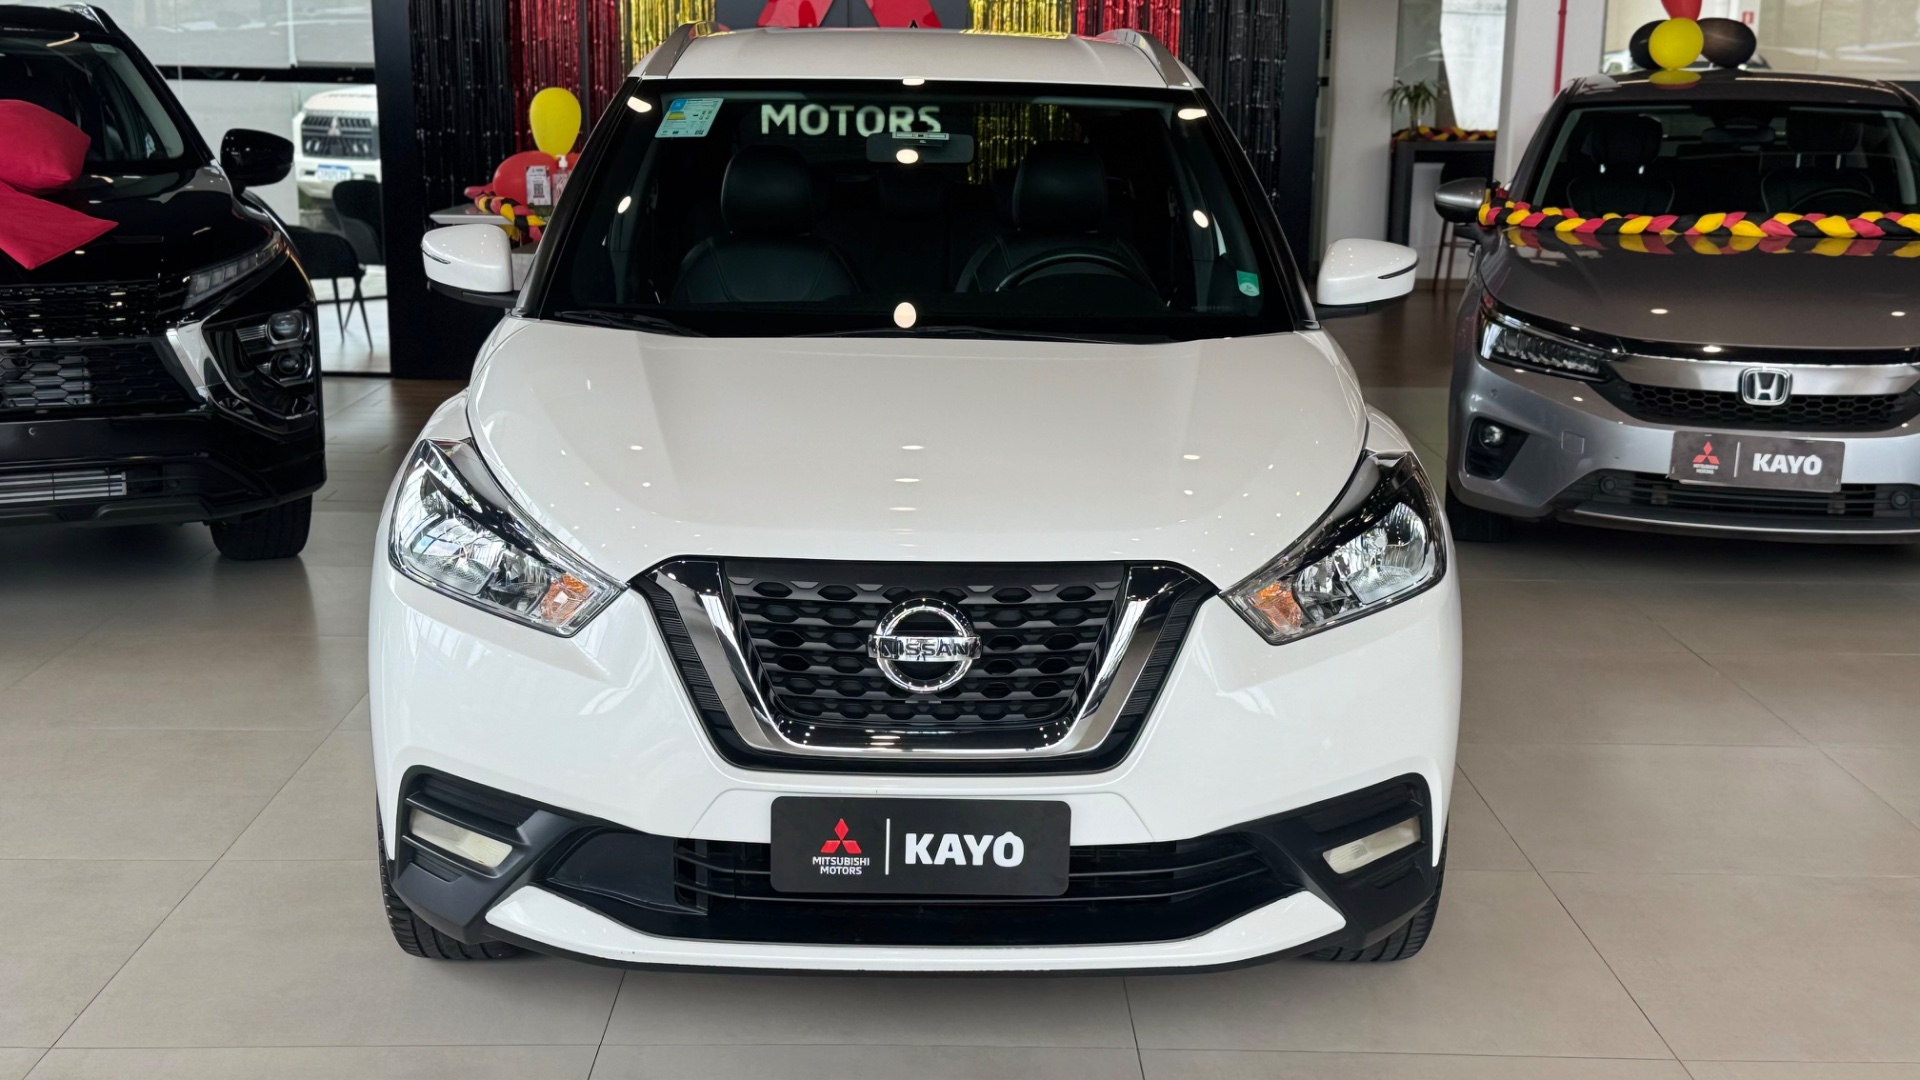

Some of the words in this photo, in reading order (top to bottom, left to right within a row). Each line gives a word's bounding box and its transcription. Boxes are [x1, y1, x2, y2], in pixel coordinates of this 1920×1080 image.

[761, 104, 942, 137] MOTORS
[1752, 453, 1823, 476] KAYÔ
[879, 637, 970, 659] NISSAN
[905, 831, 1025, 868] KAYÔ
[812, 856, 870, 867] MITSUBISHI
[820, 866, 862, 875] MOTORS
